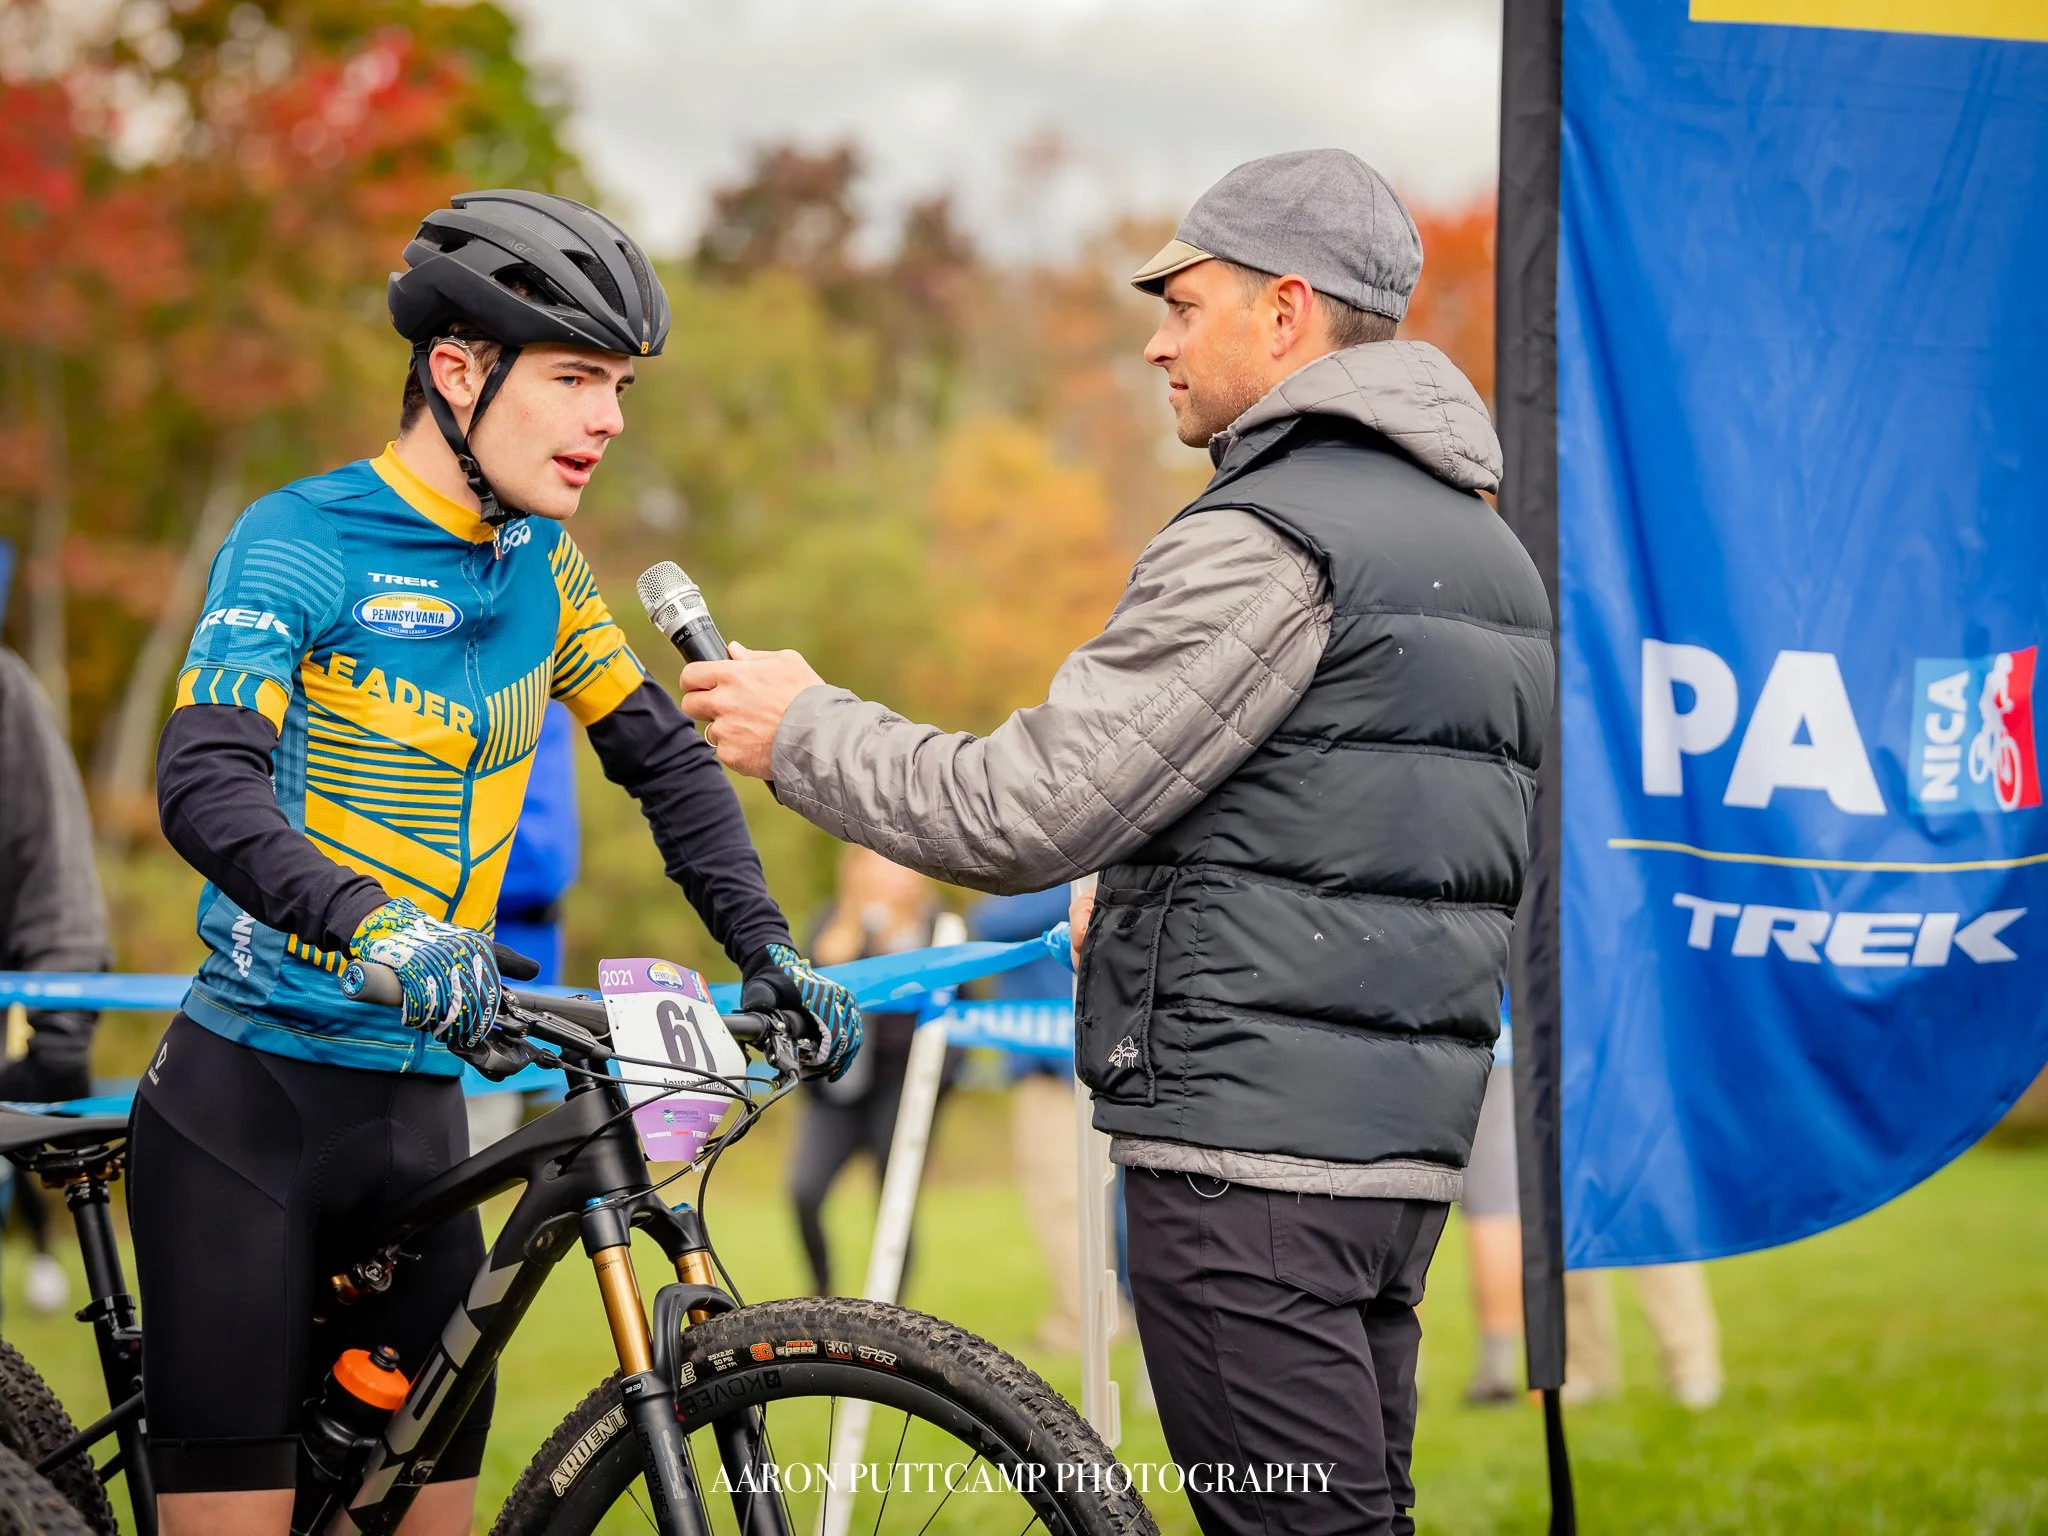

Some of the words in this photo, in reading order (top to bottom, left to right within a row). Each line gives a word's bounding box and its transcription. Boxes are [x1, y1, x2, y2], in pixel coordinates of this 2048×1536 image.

[367, 572, 440, 589] TREK
[190, 608, 290, 642] REK
[372, 608, 444, 624] PENNSYLVANIA
[302, 650, 477, 739] LEADER
[1641, 637, 1888, 816] PA
[1919, 670, 1970, 802] NICA
[1672, 892, 2028, 967] TREK
[601, 969, 634, 987] 2021
[466, 1007, 493, 1048] CRUSHED
[487, 986, 498, 1005] MX
[656, 1000, 717, 1073] 61
[722, 1355, 734, 1364] PSI
[750, 1342, 775, 1361] 3C
[826, 1340, 853, 1355] EXO
[858, 1344, 897, 1366] TR
[322, 1250, 525, 1536] REK
[550, 1403, 628, 1497] ARDENT
